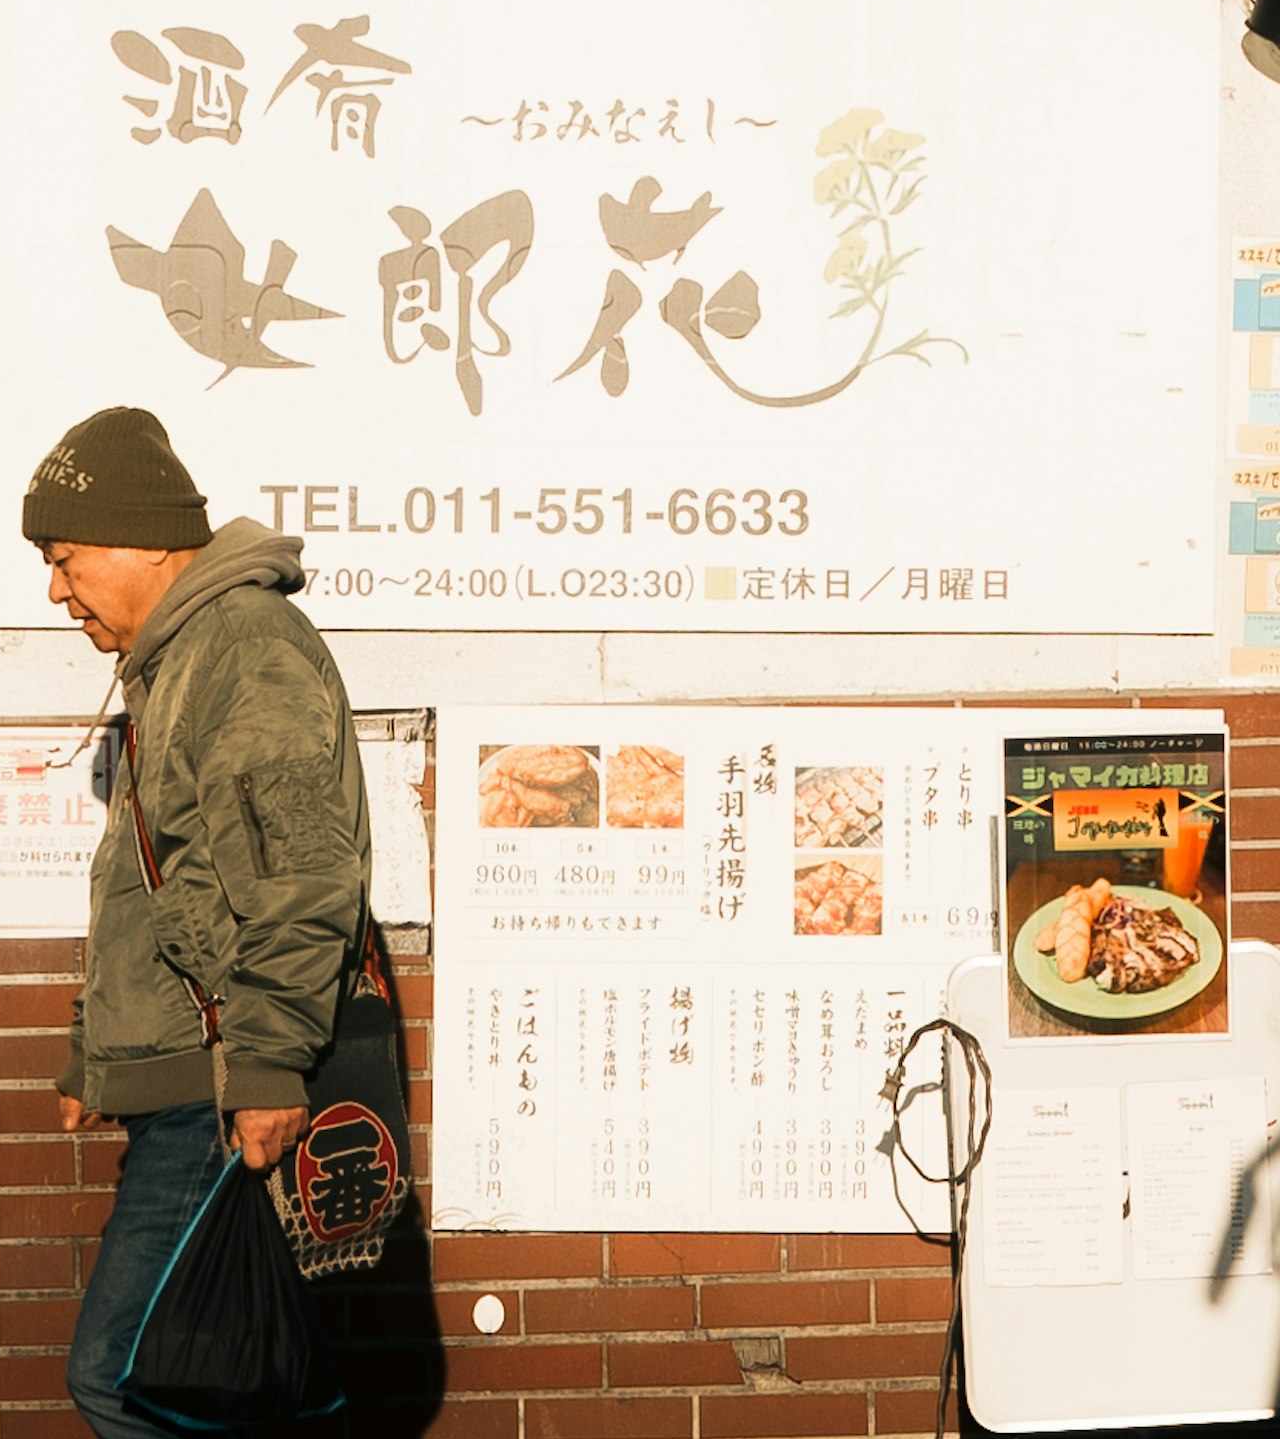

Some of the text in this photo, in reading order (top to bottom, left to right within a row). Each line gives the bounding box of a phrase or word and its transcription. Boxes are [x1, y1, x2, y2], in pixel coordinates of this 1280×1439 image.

[110, 14, 412, 158] 酒肴
[104, 175, 862, 417] 女郎花
[922, 761, 942, 832] ブタ串
[957, 763, 974, 832] とり串
[1021, 763, 1210, 790] ジャマイカ料理店
[476, 863, 538, 886] 960円
[553, 863, 616, 886] 480円
[637, 863, 686, 886] 99円
[715, 754, 747, 922] 手羽先揚げ
[486, 988, 503, 1199] やきとり丼 590円
[516, 987, 540, 1118] ごはんもの
[635, 987, 652, 1199] フライドポテト 390円
[852, 989, 869, 1200] えだまめ 390円
[601, 1117, 616, 1199] 540円
[749, 1118, 764, 1200] 490円
[784, 1117, 799, 1200] 390円
[818, 1117, 833, 1200] 390円
